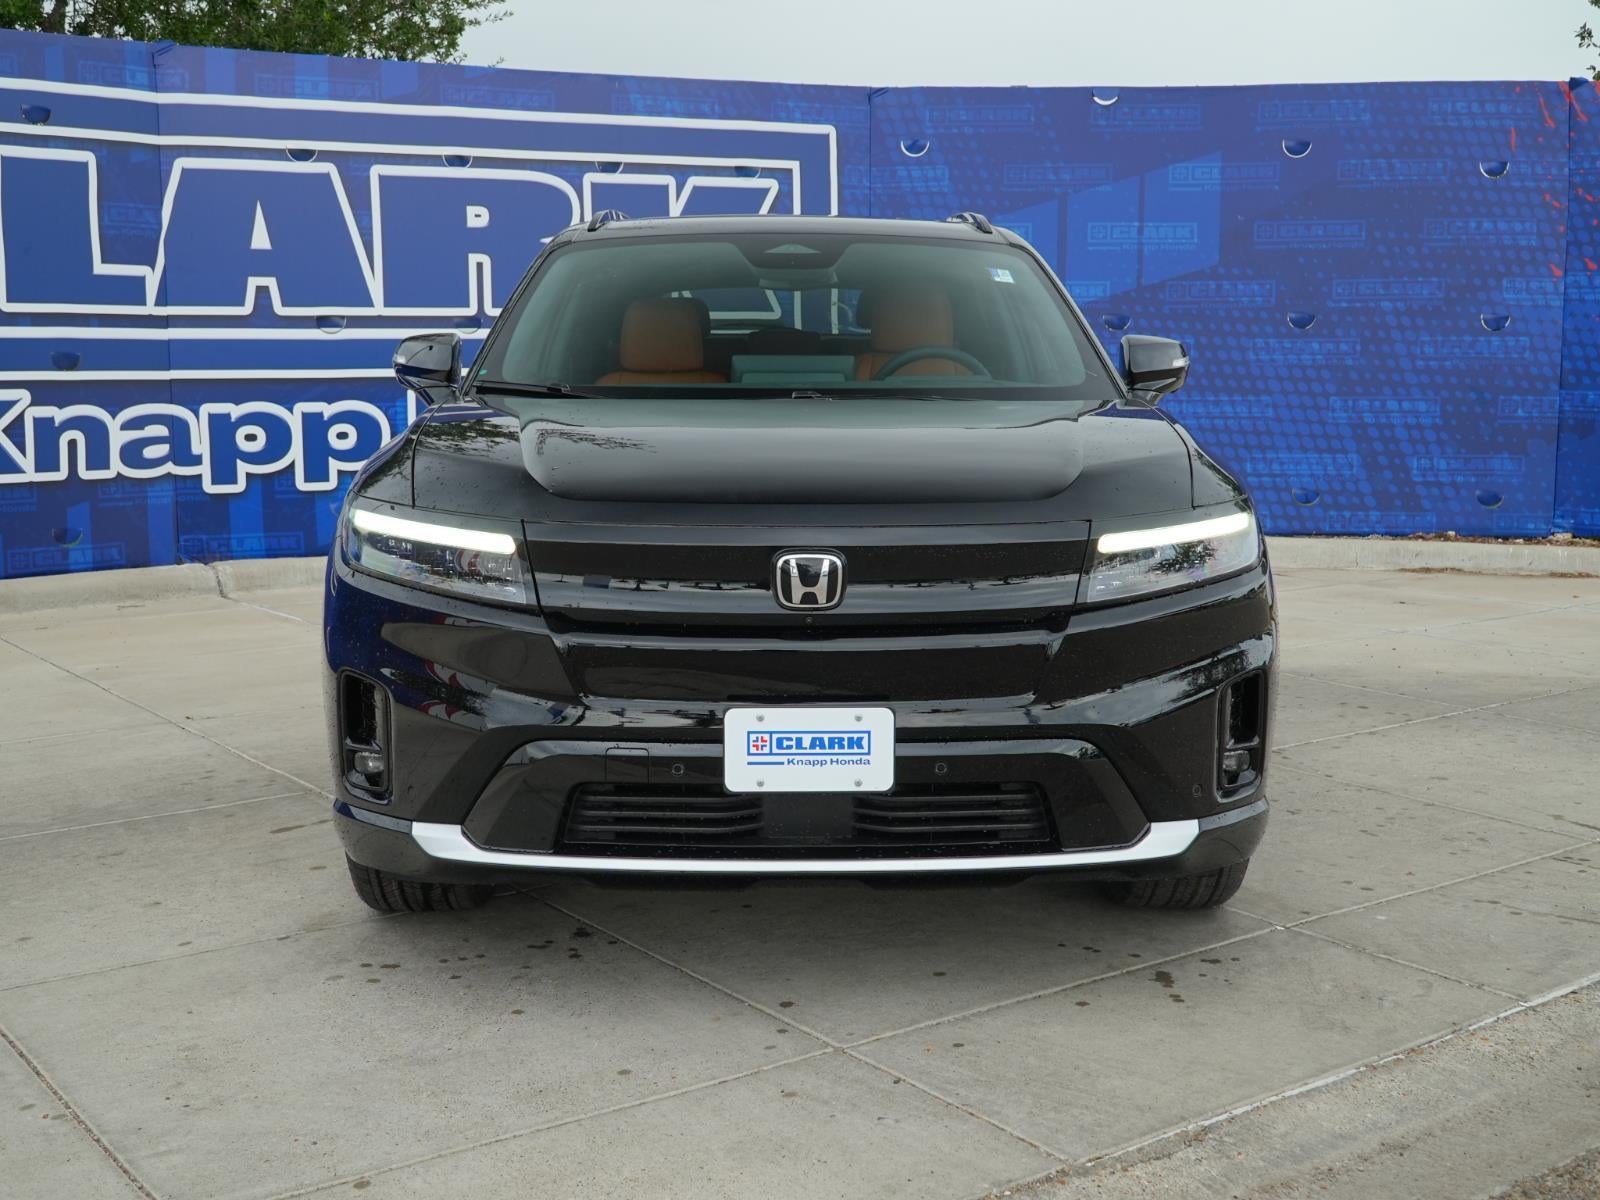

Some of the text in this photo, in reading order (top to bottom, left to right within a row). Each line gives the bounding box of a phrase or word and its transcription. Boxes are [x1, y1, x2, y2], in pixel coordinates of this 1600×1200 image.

[775, 736, 865, 750] CLARK
[787, 757, 871, 767] Knapp Honda
